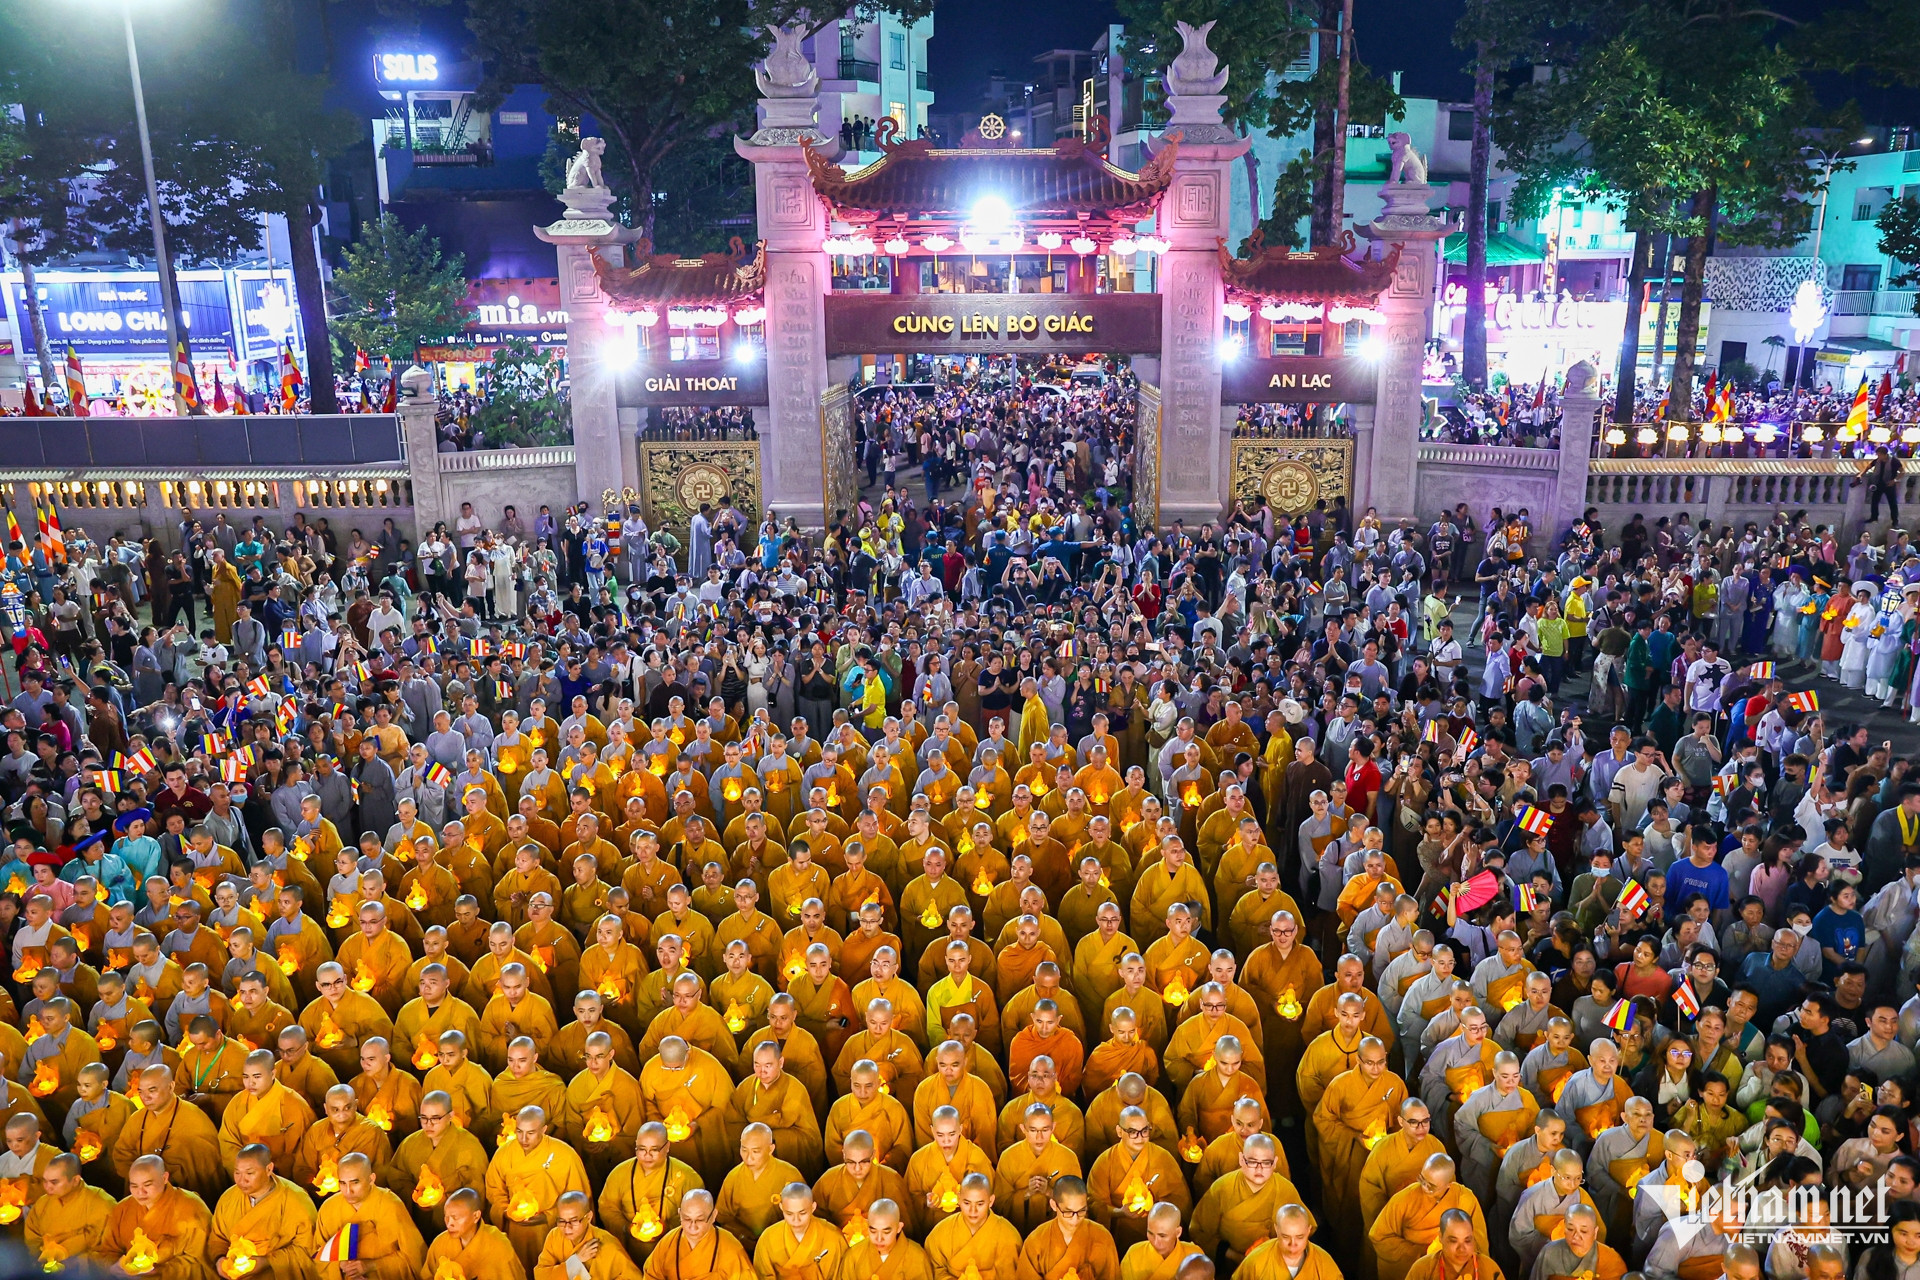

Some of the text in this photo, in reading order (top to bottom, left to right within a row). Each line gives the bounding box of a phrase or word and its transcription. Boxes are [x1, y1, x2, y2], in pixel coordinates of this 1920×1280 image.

[382, 54, 438, 81] SOLIS
[477, 295, 569, 325] mia.vn
[58, 311, 122, 331] LONG
[893, 311, 1093, 333] CÙNG LÊN BỜ GIÁC
[645, 373, 738, 392] GIẢI THOÁT
[1268, 374, 1332, 391] AN LẠC
